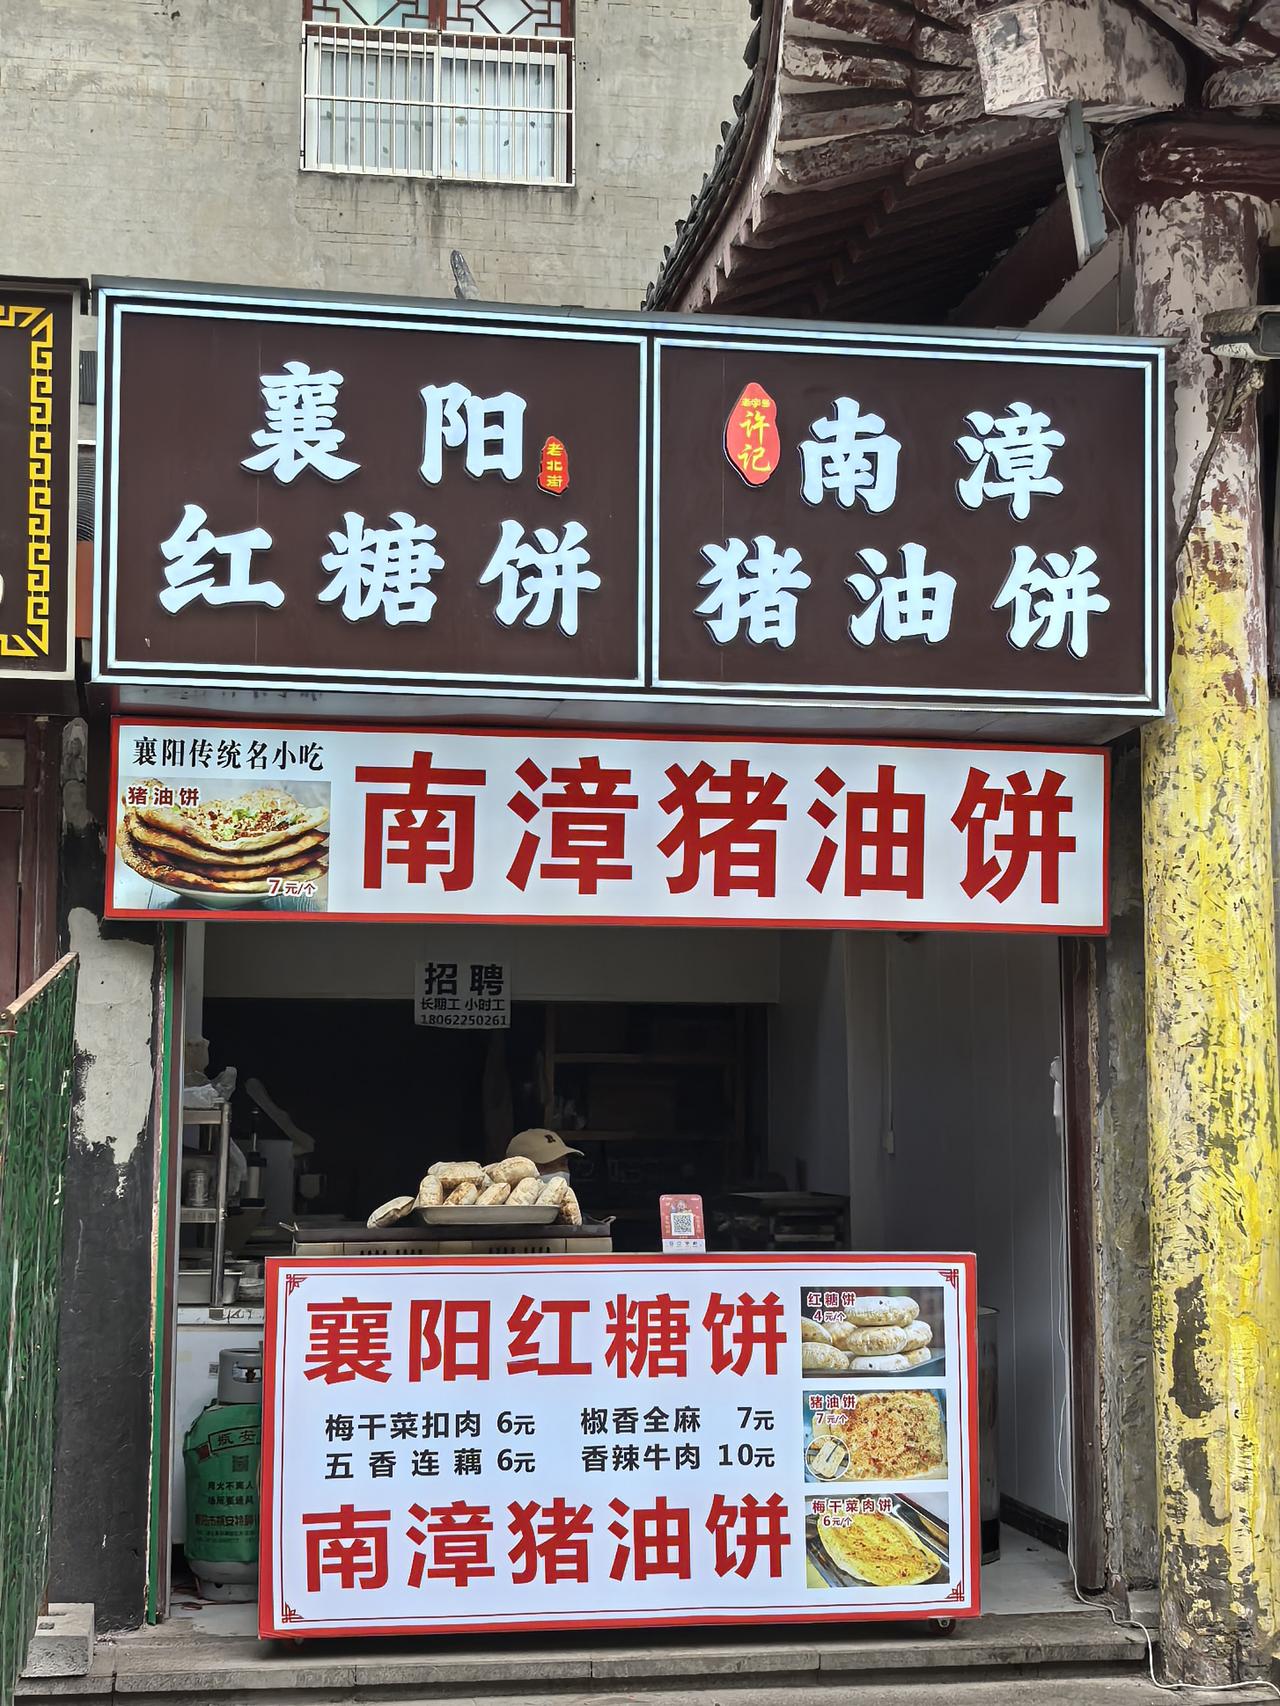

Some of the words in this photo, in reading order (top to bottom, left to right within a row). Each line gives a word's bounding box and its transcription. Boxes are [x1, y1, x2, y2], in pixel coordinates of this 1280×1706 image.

[241, 361, 527, 484] 襄阳
[737, 410, 773, 471] 许记
[546, 442, 564, 488] 老北街
[800, 396, 1066, 520] 南漳
[158, 503, 601, 636] 红糖饼
[695, 535, 1111, 660] 猪油饼
[132, 736, 324, 771] 襄阳传统名小吃
[127, 786, 200, 807] 猪油饼
[355, 750, 1077, 904] 南漳猪油饼
[266, 877, 316, 896] 7元/个
[424, 962, 504, 996] 招聘
[420, 1014, 508, 1026] 18062250261
[421, 997, 461, 1010] 长期工
[465, 998, 505, 1011] 小时工
[806, 1291, 857, 1307] 红糖饼
[812, 1309, 847, 1322] 4元/个
[303, 1291, 787, 1385] 襄阳红糖饼
[809, 1393, 857, 1410] 猪油饼
[325, 1410, 481, 1442] 梅干菜扣肉
[496, 1410, 536, 1436] 6元
[580, 1405, 701, 1435] 椒香全麻
[737, 1406, 775, 1431] 7元
[816, 1412, 849, 1426] 7元/个
[324, 1447, 482, 1480] 五香连藕
[497, 1448, 536, 1474] 6元
[581, 1442, 701, 1473] 香辣牛肉
[717, 1443, 775, 1468] 10元
[811, 1497, 893, 1514] 梅干菜肉饼
[822, 1515, 853, 1528] 6元/个
[302, 1492, 791, 1593] 南漳猪油饼
